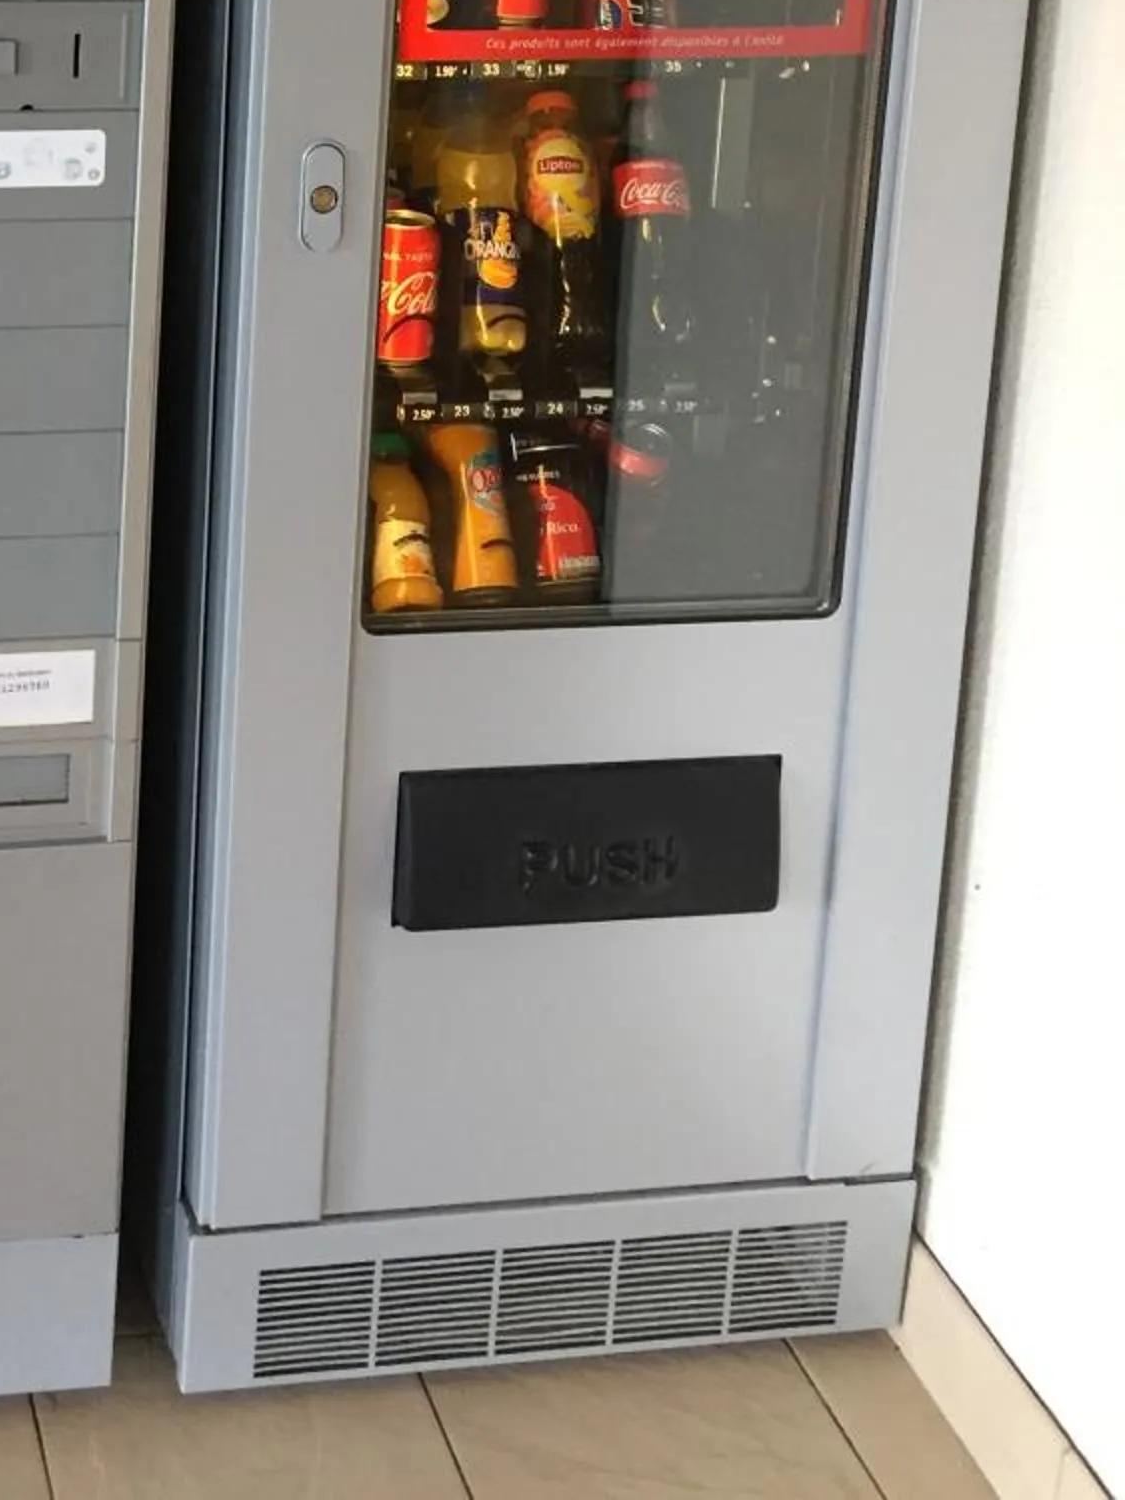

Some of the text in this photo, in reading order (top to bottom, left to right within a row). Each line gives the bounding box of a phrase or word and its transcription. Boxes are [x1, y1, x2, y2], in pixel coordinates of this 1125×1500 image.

[509, 37, 559, 51] produits
[538, 159, 581, 172] Lipton
[519, 834, 679, 894] PUSH
